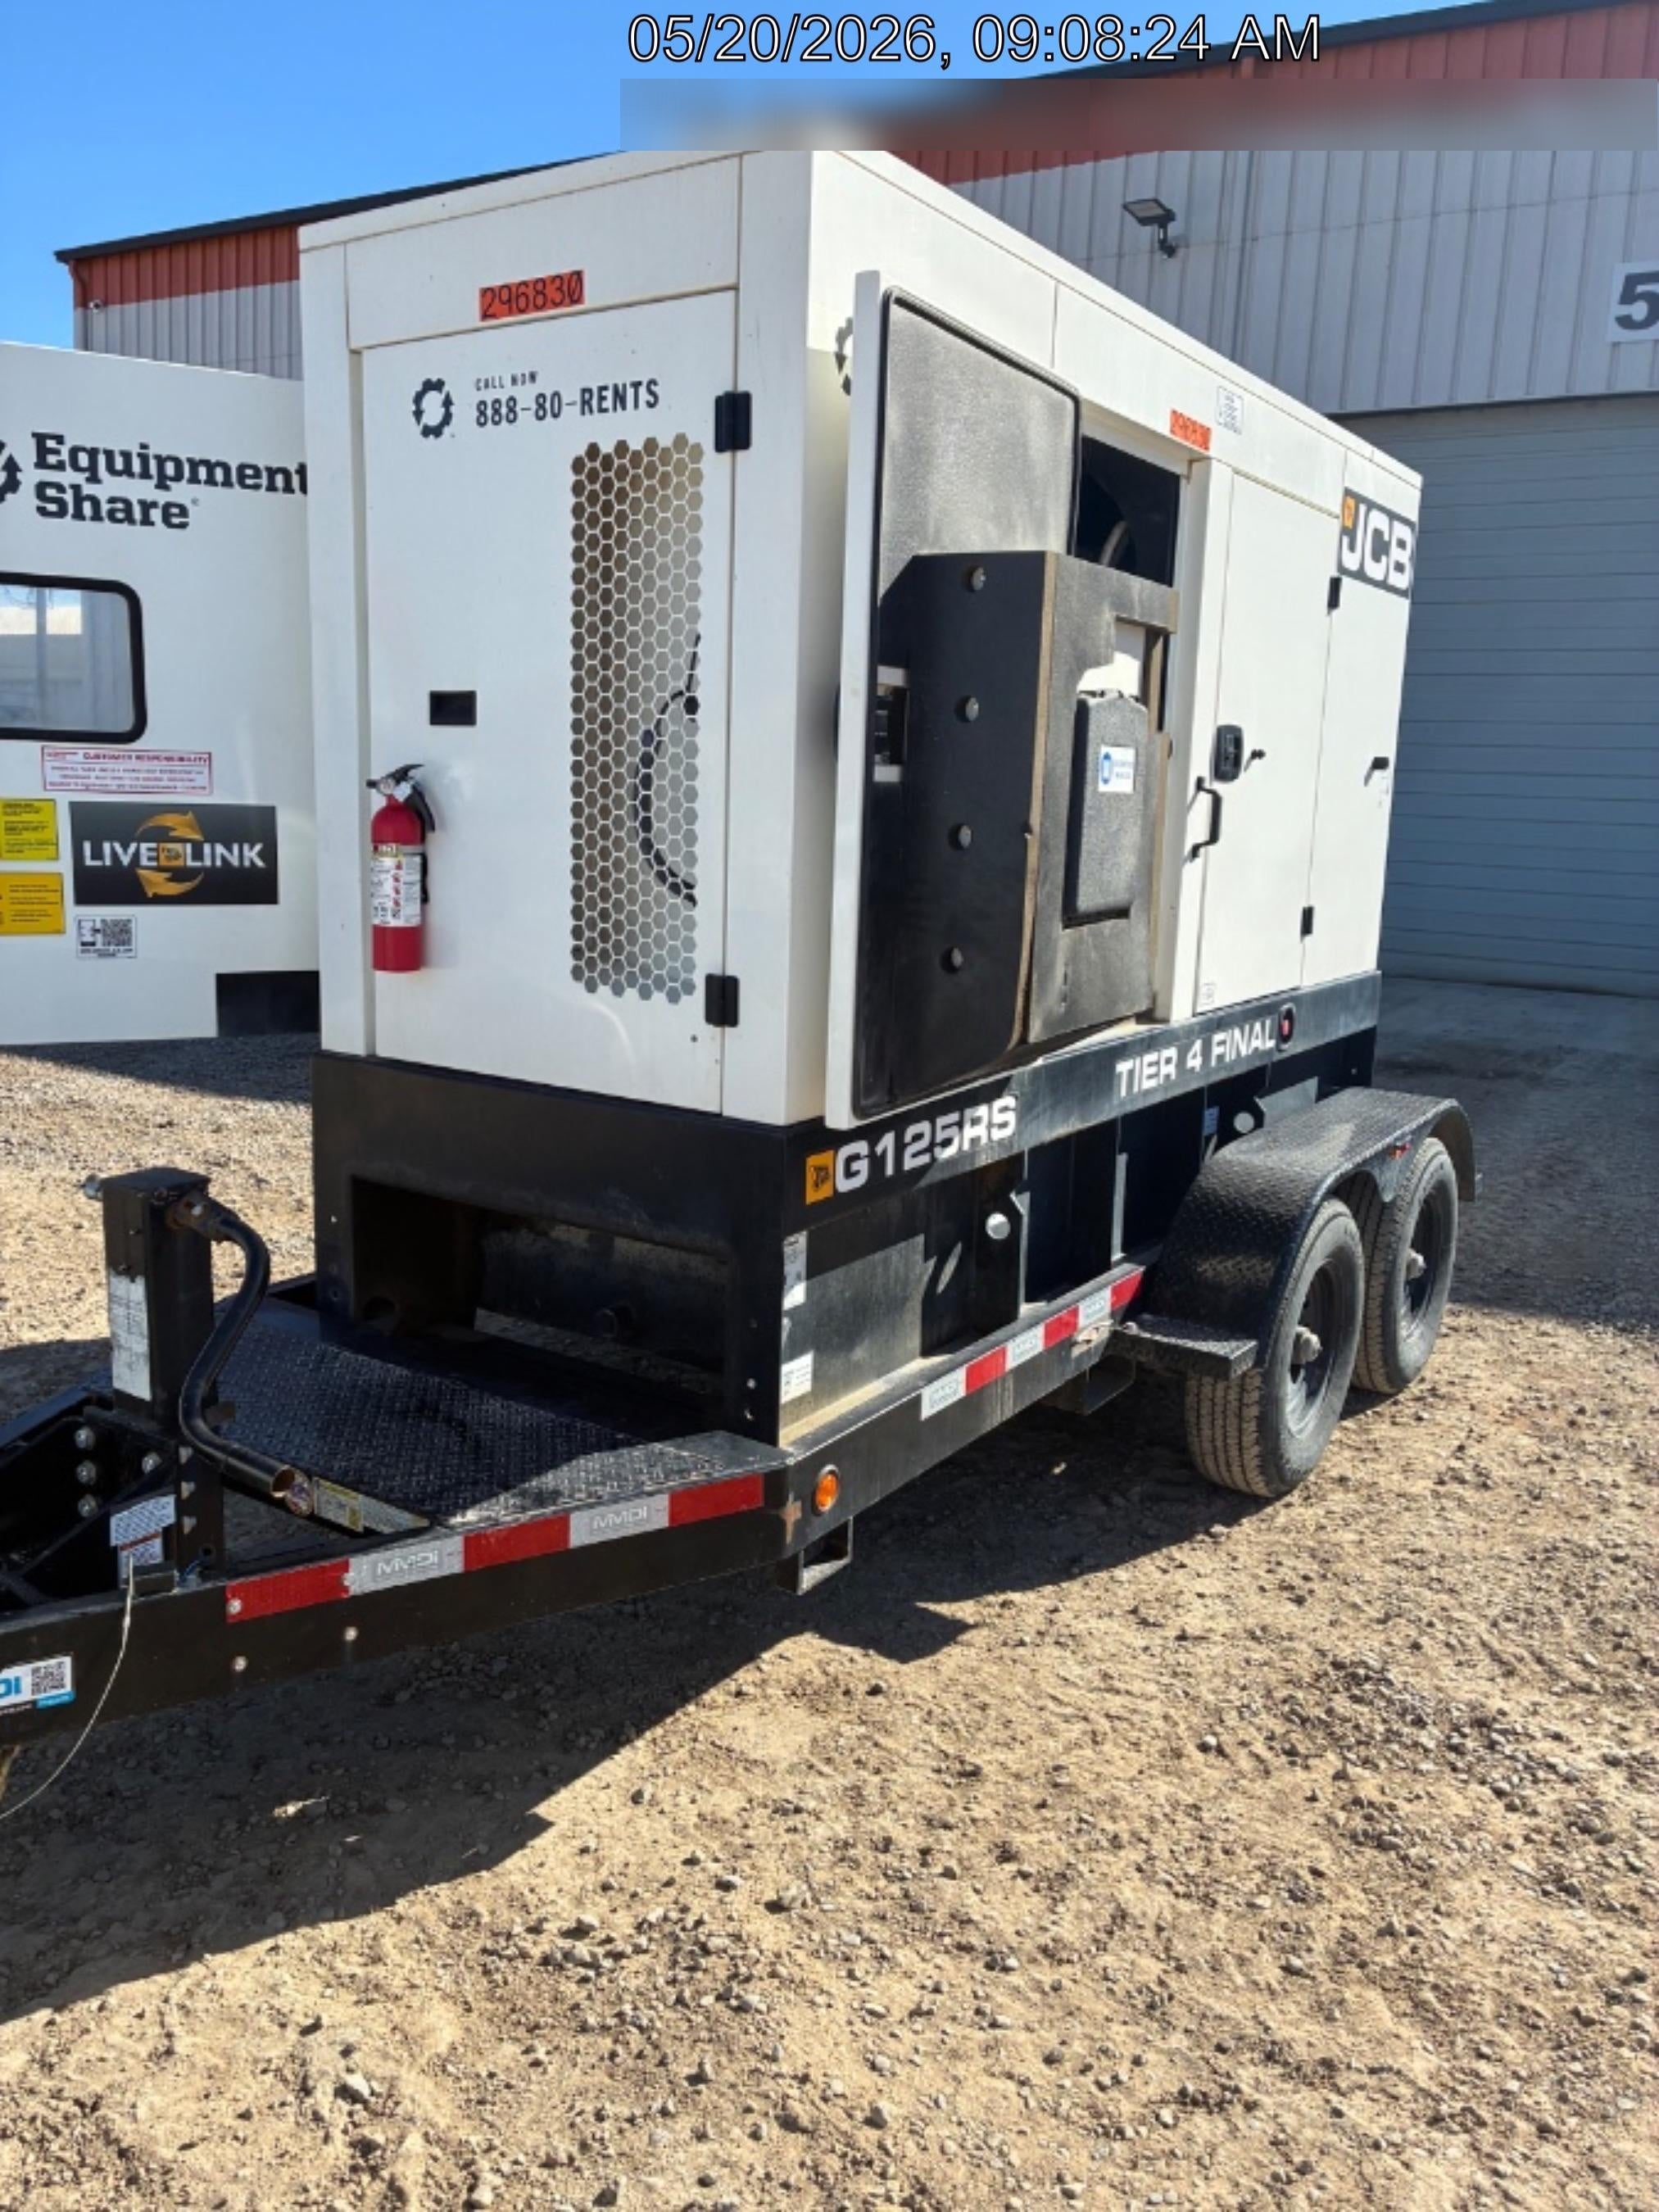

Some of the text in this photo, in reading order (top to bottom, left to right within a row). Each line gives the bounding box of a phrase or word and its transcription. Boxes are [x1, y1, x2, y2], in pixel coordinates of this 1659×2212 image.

[480, 271, 584, 320] 296830
[475, 370, 537, 392] CALL NOW
[476, 378, 660, 428] 888-80-RENTS
[31, 432, 307, 496] Equipment
[1341, 502, 1412, 590] JCB
[83, 841, 158, 868] LIVE
[186, 841, 267, 868] LINK
[1116, 1015, 1277, 1098] TIER 4 FINAL
[834, 1095, 1017, 1194] G125RS
